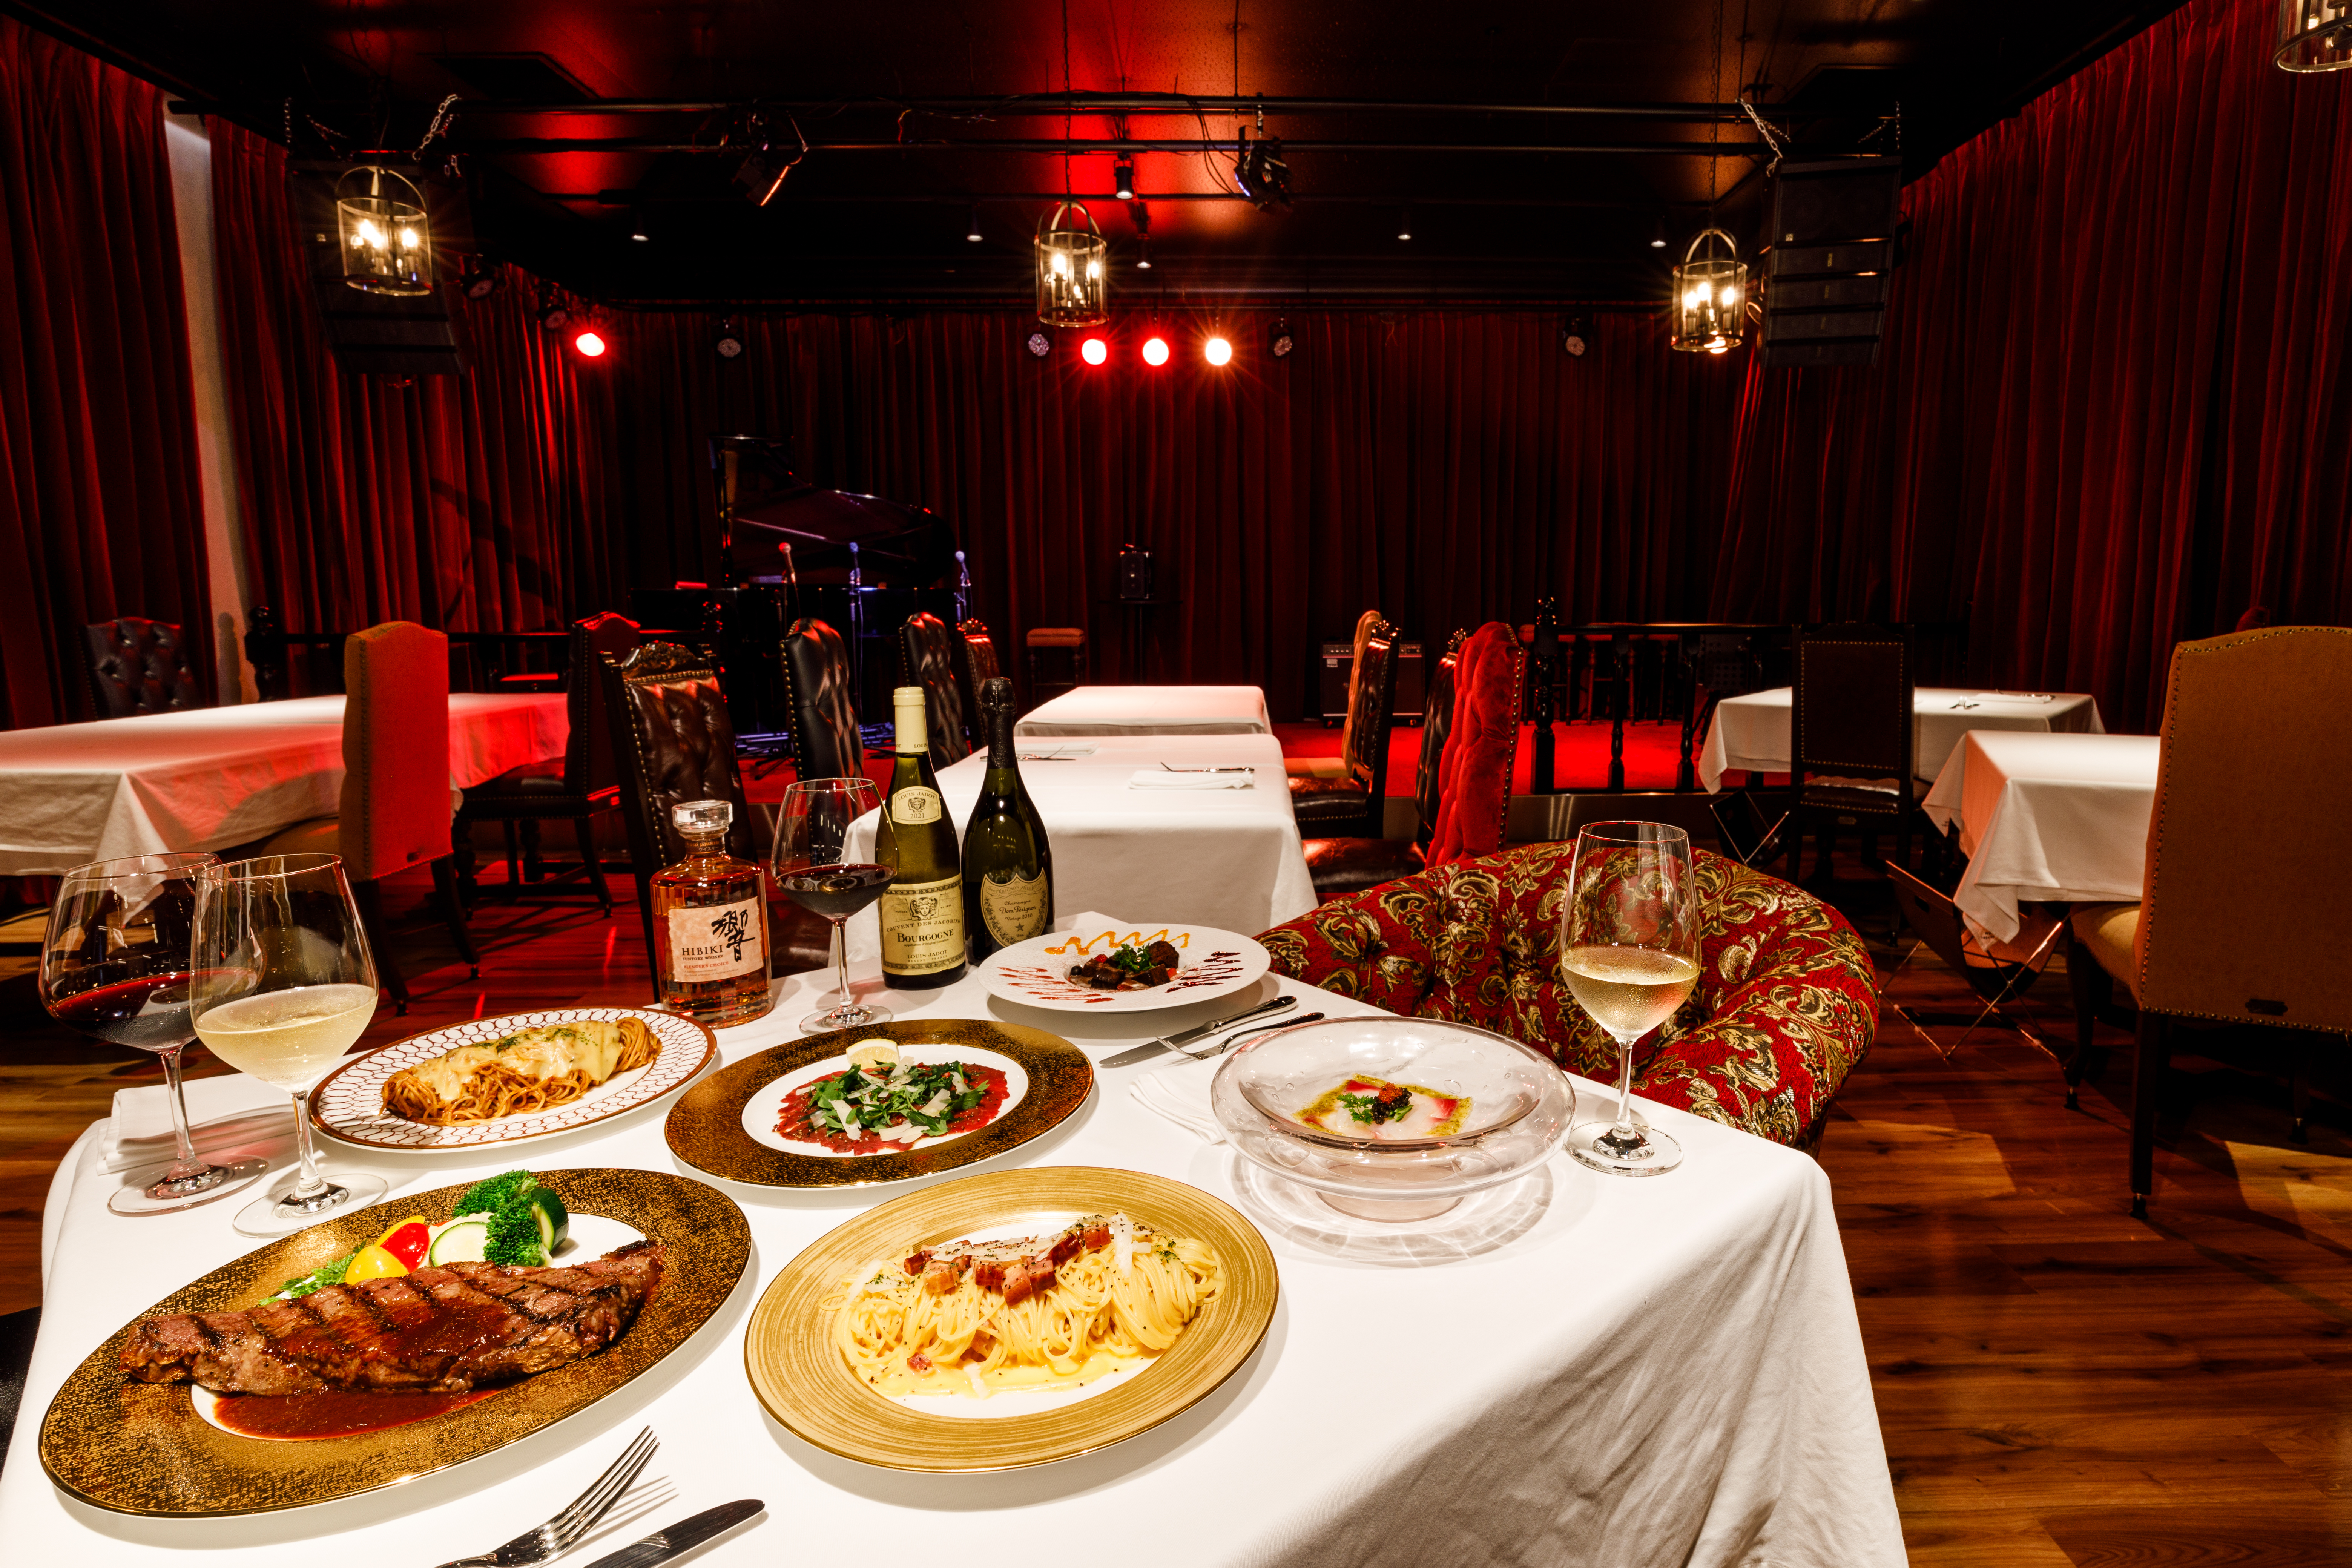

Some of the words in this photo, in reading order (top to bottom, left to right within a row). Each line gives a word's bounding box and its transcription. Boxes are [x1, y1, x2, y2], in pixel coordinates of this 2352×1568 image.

[898, 792, 915, 801] LOUIS
[887, 923, 914, 932] COUVENT
[897, 929, 954, 942] BOURGOGNE
[682, 945, 723, 956] HIBIKI
